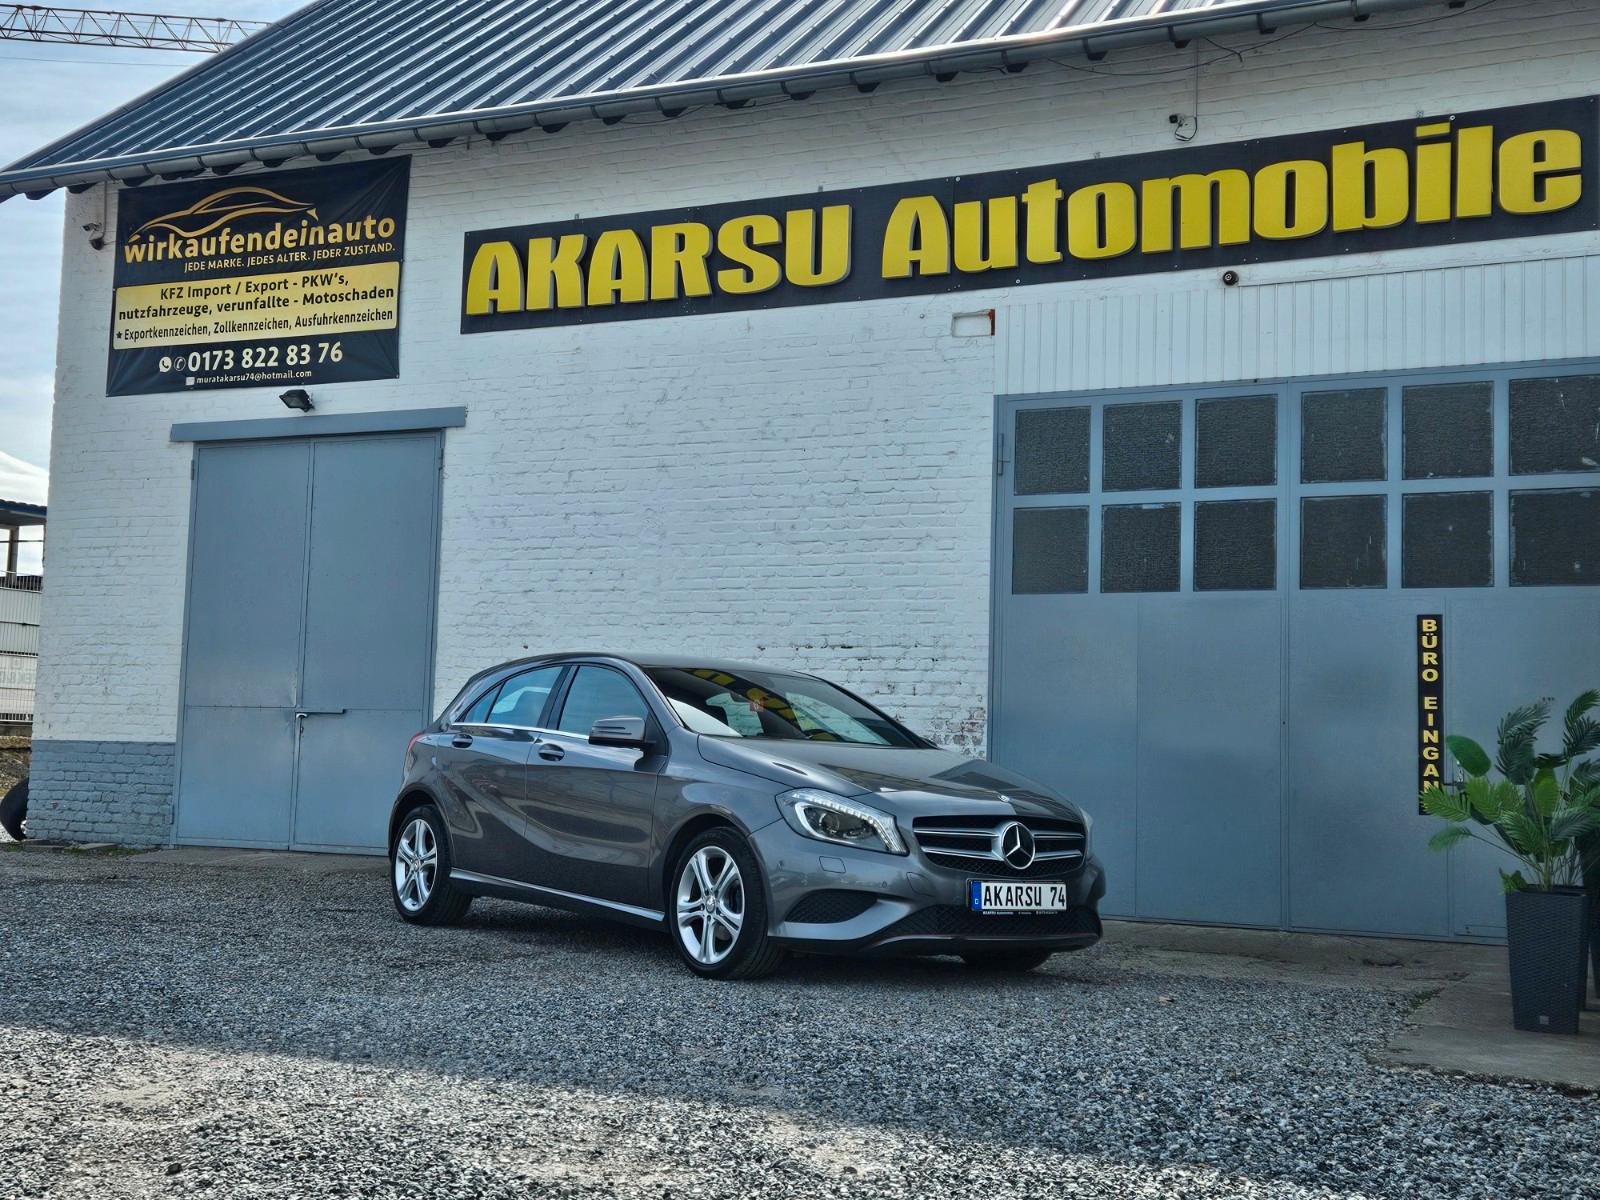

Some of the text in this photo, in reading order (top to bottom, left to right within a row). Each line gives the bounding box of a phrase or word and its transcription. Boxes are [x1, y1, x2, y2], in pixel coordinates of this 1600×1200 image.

[465, 122, 1583, 316] AKARSU Automobile
[124, 215, 395, 263] wirkaufendeinauto
[184, 242, 396, 273] JEDE MARKE. JEDES ALTER. JEDER ZUSTAND.
[119, 304, 213, 320] nutzfahrzeuge,
[216, 296, 290, 313] verunfallte
[302, 286, 394, 305] Motoschaden
[160, 287, 184, 301] KFZ
[187, 284, 232, 300] Import
[245, 279, 289, 295] Export
[124, 308, 393, 342] Exportkennzeichen, Zollkennzeichen, Ausfuhrkennzeichen
[187, 341, 343, 372] 0173 822 83 76
[196, 370, 312, 384] muratakarsu74@hotmail.com
[1421, 619, 1440, 793] BÜRO EINGAN
[983, 885, 1065, 907] AKARSU 74
